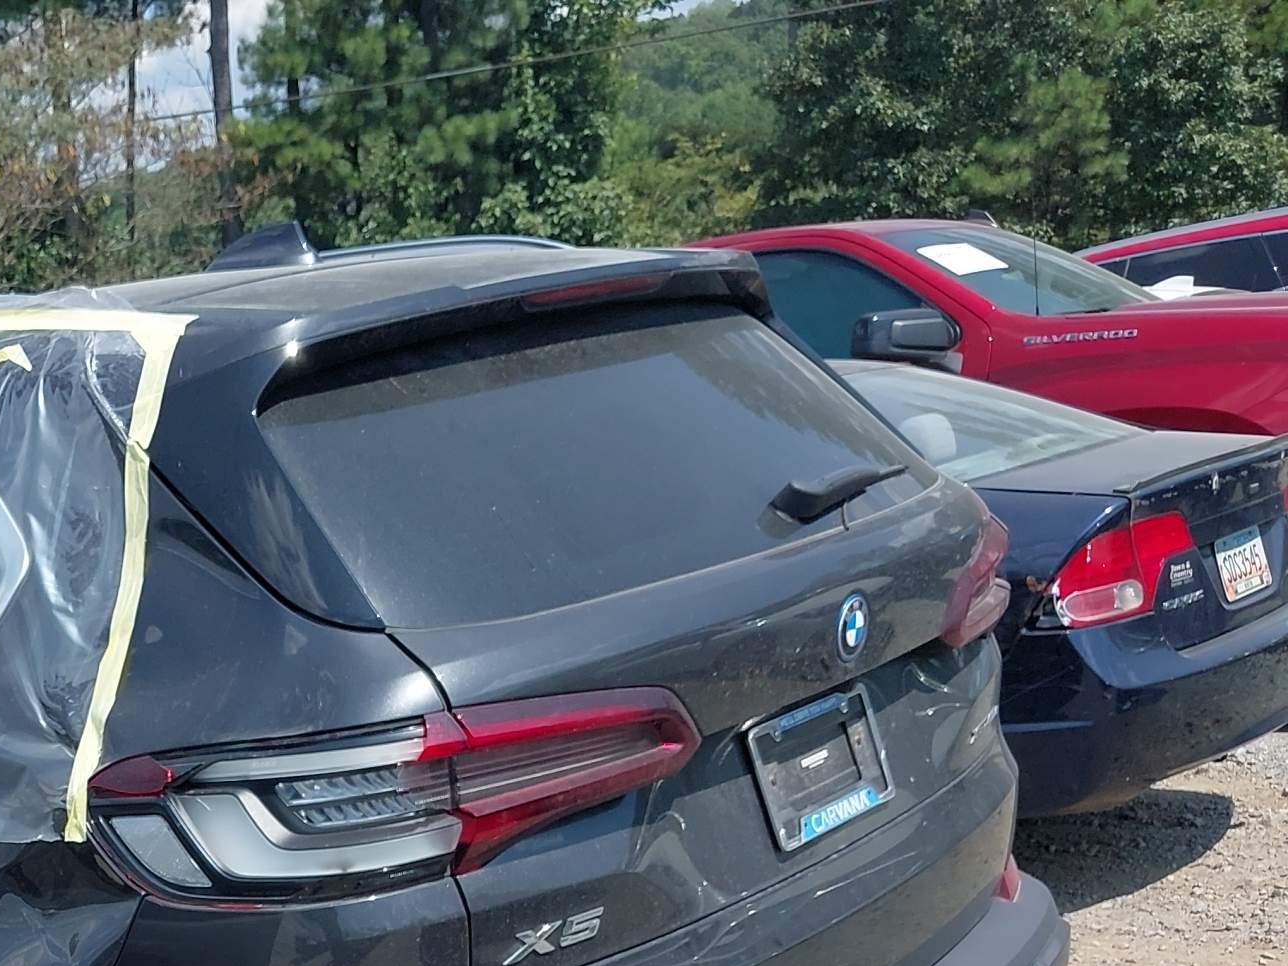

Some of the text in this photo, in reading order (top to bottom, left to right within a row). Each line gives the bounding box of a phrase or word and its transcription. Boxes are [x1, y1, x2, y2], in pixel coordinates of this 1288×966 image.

[1023, 329, 1138, 346] SILVERADO
[811, 788, 871, 833] CARVANA
[500, 906, 605, 966] X5
